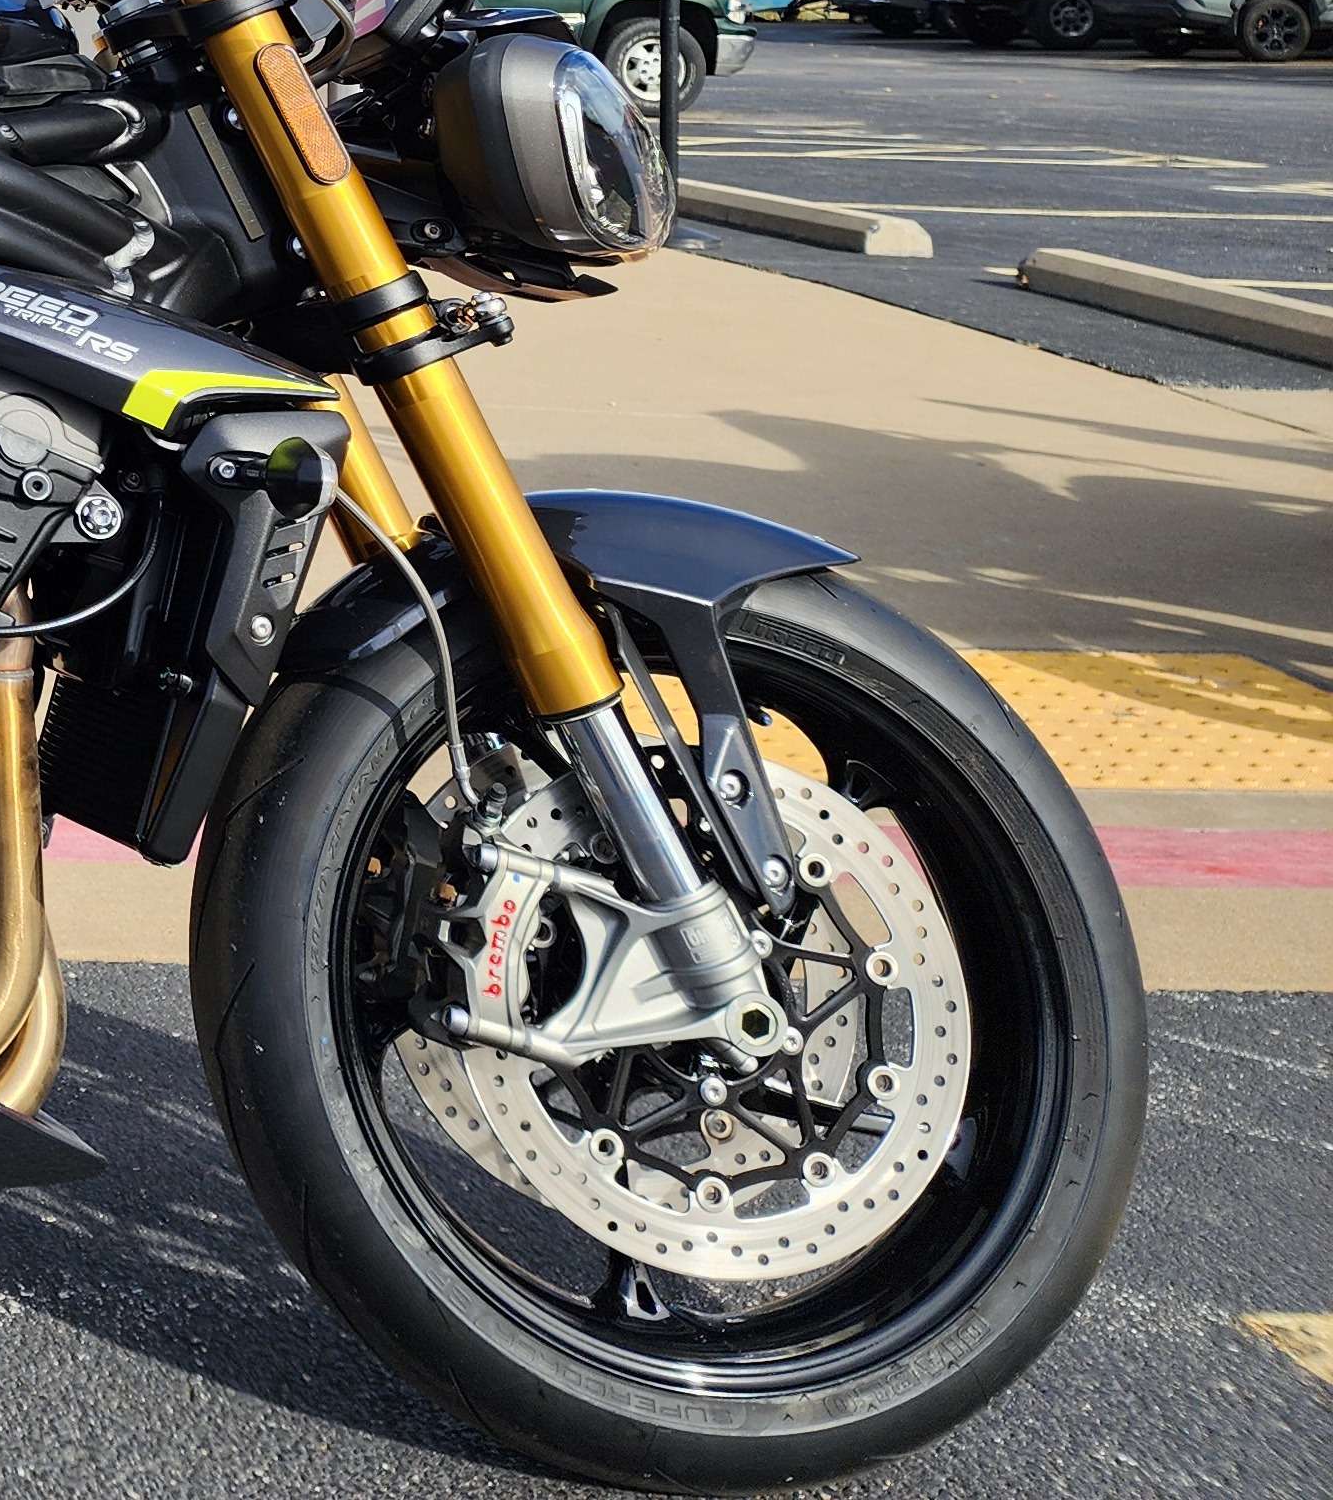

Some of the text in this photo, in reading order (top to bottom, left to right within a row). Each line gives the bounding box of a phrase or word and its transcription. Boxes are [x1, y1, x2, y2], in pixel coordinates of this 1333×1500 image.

[3, 303, 140, 365] TRIPLE RS
[482, 899, 517, 999] brembo
